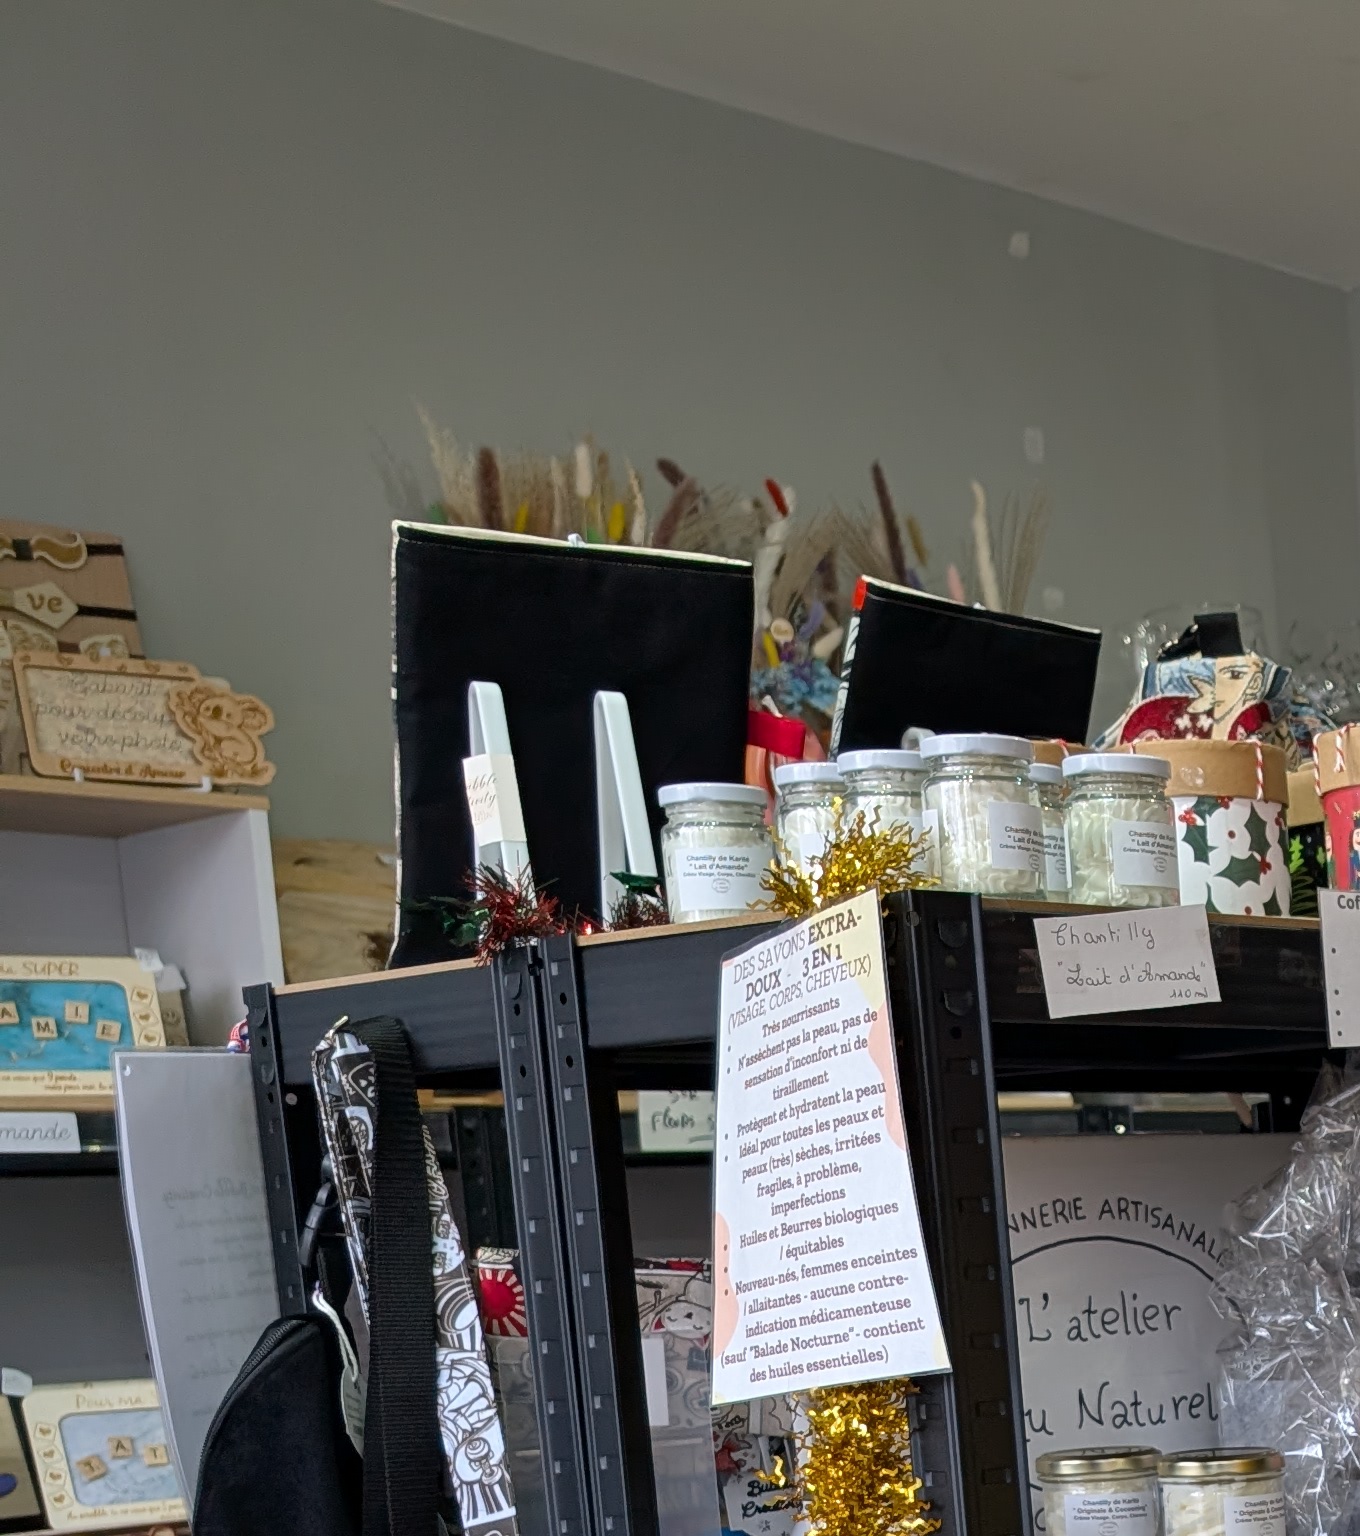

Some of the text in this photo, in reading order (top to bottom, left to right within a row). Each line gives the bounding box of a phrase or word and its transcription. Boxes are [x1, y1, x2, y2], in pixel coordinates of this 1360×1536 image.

[733, 908, 862, 984] DES SAVONS EXTRA-
[1051, 922, 1154, 949] Chantilly
[22, 963, 79, 976] SUPER
[745, 943, 842, 1002] DOUX 3 EN 1
[728, 954, 872, 1035] (VISAGE, CORPS, CHEVEUX)
[738, 1008, 878, 1071] N'assèchent pas la peau, pas de
[762, 998, 840, 1038] Très nourrissants
[772, 1070, 829, 1100] tiraillement
[737, 1081, 886, 1137] Protègent et hydratent la peau
[771, 1187, 846, 1216] imperfections
[735, 1248, 918, 1295] Nouveau-nés, femmes enceintes
[746, 1298, 911, 1338] indication médicamenteuse
[721, 1317, 925, 1369] (sauf "Balade Nocturne" contient
[750, 1345, 889, 1383] des huiles essentielles)
[1078, 1381, 1219, 1429] Naturel
[1082, 1499, 1111, 1507] Chantilly
